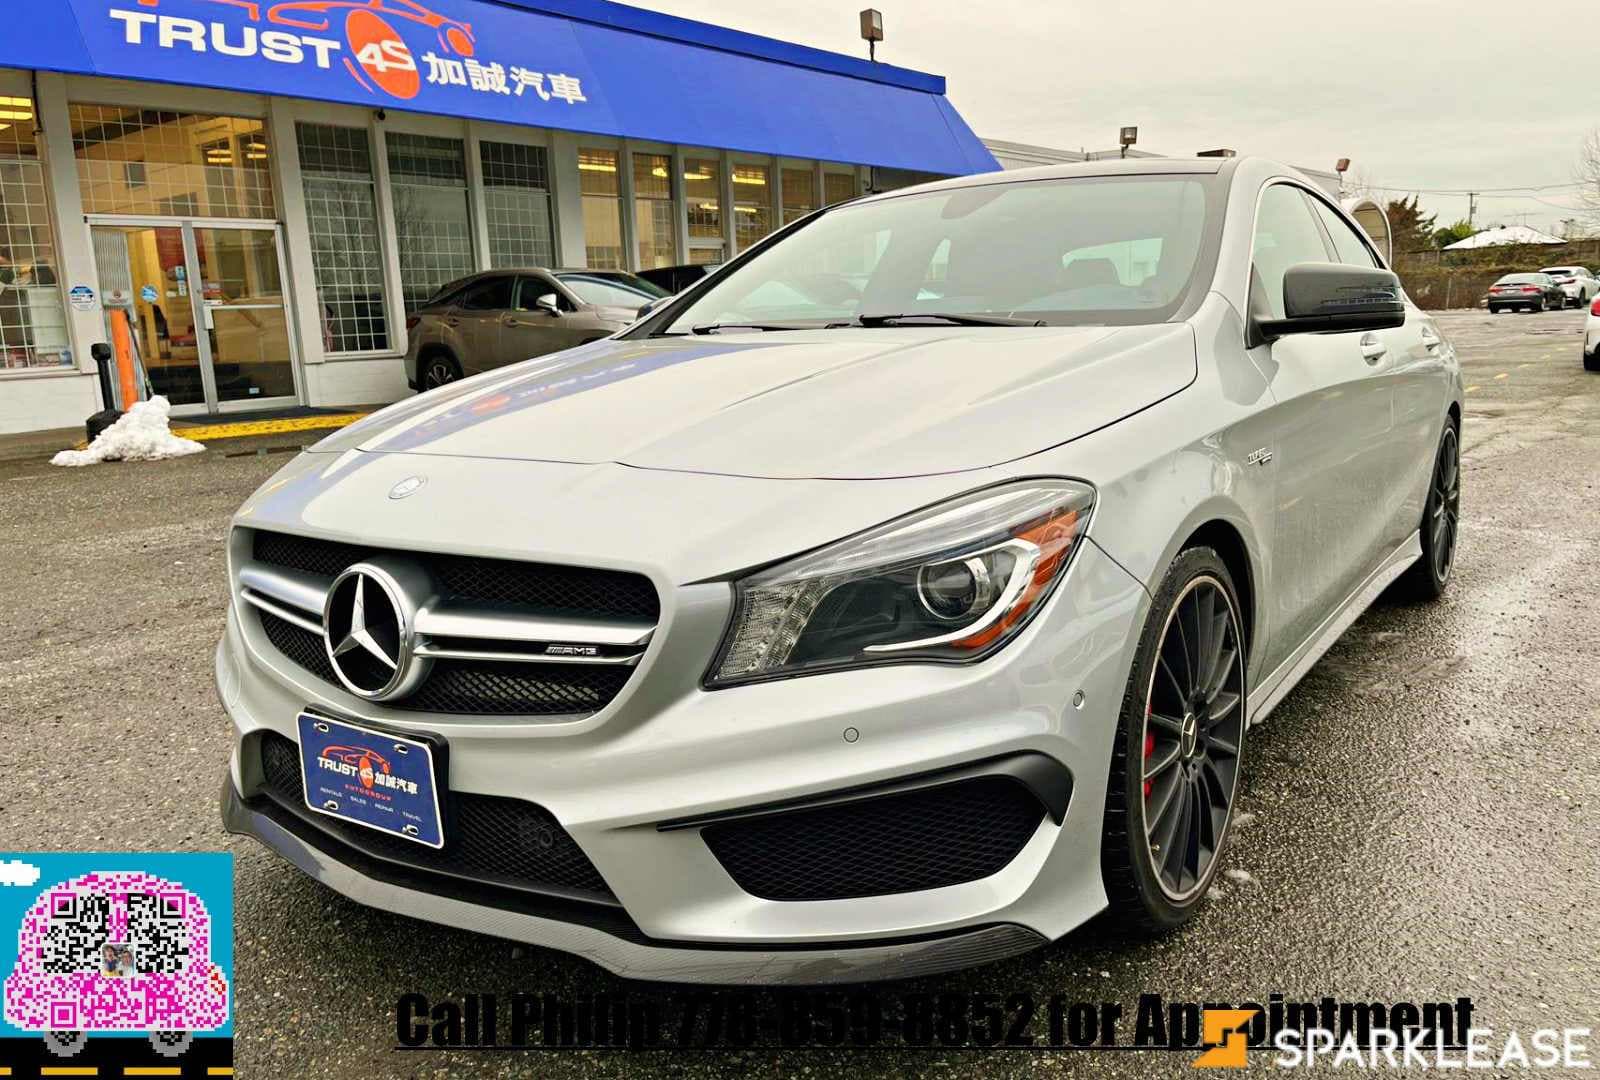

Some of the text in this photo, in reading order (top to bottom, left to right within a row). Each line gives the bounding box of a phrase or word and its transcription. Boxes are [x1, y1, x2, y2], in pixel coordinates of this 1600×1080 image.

[109, 9, 588, 105] TRUST 4S 加誠汽車
[317, 756, 358, 777] TRUST
